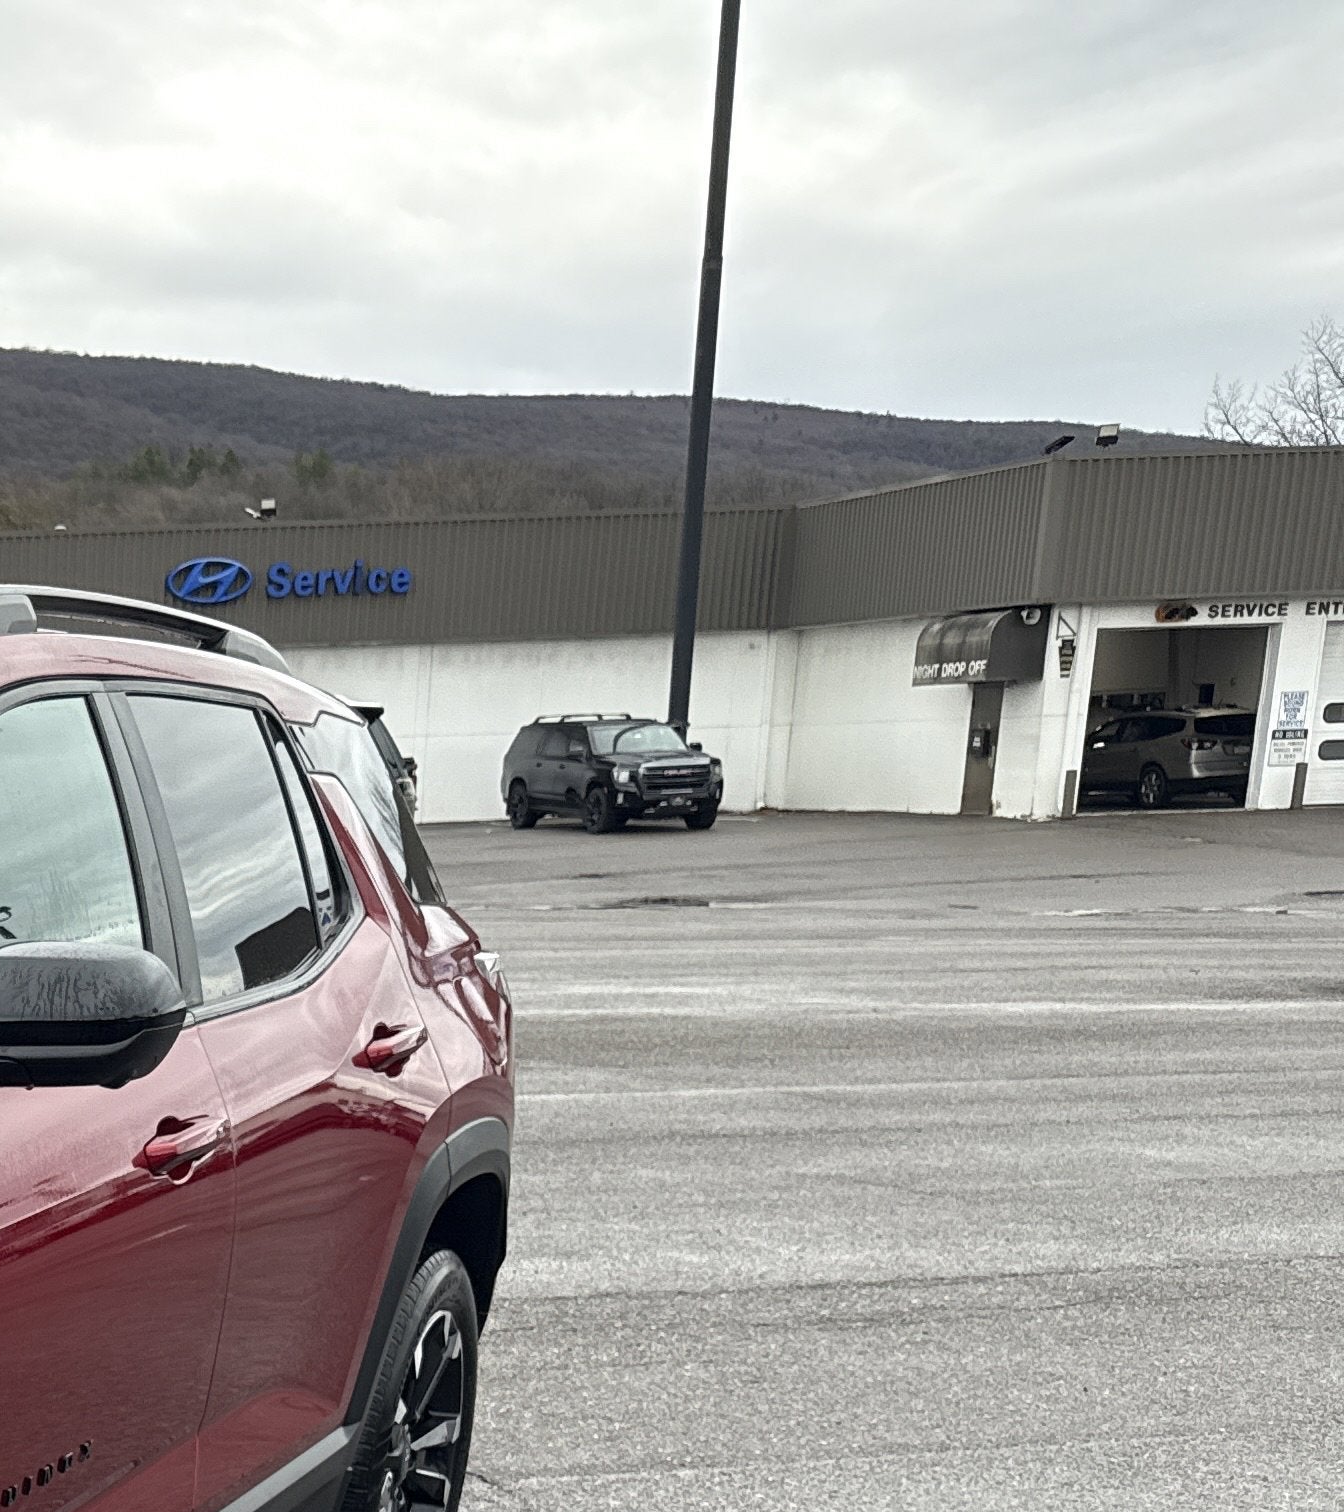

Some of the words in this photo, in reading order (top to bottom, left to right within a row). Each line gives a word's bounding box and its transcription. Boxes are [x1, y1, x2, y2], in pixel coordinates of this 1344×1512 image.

[266, 559, 412, 599] Service
[1208, 602, 1289, 619] SERVICE
[1305, 601, 1344, 616] ENT
[913, 663, 940, 679] NIGHT
[941, 661, 967, 678] DROP
[968, 660, 988, 676] OFF
